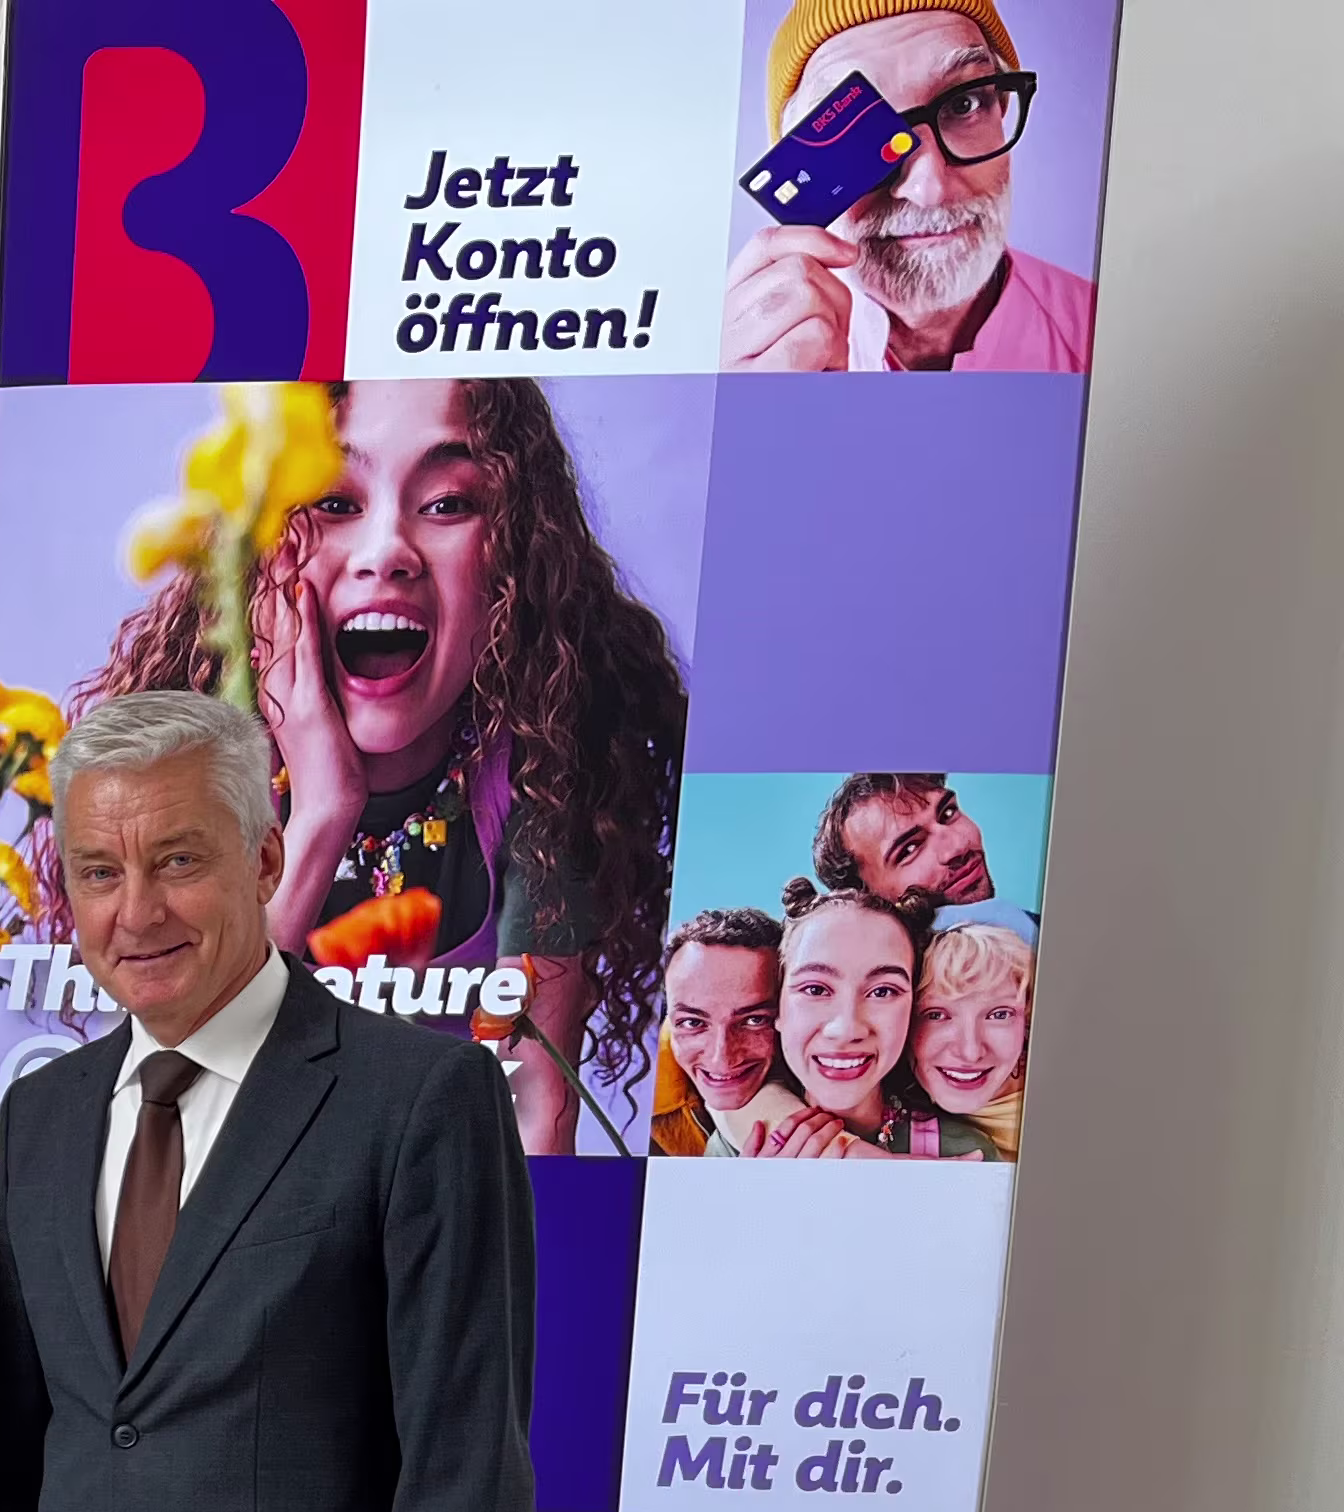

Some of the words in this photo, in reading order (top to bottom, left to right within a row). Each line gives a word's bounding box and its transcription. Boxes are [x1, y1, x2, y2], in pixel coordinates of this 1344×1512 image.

[811, 108, 837, 133] BKS
[832, 86, 863, 114] Bank
[403, 150, 580, 210] Jetzt
[401, 221, 617, 281] Konto
[396, 289, 659, 354] öffnen!
[312, 954, 528, 1016] ature
[662, 1371, 778, 1426] Für
[794, 1374, 961, 1433] dich.
[656, 1434, 779, 1491] Mit
[795, 1438, 903, 1495] dir.
